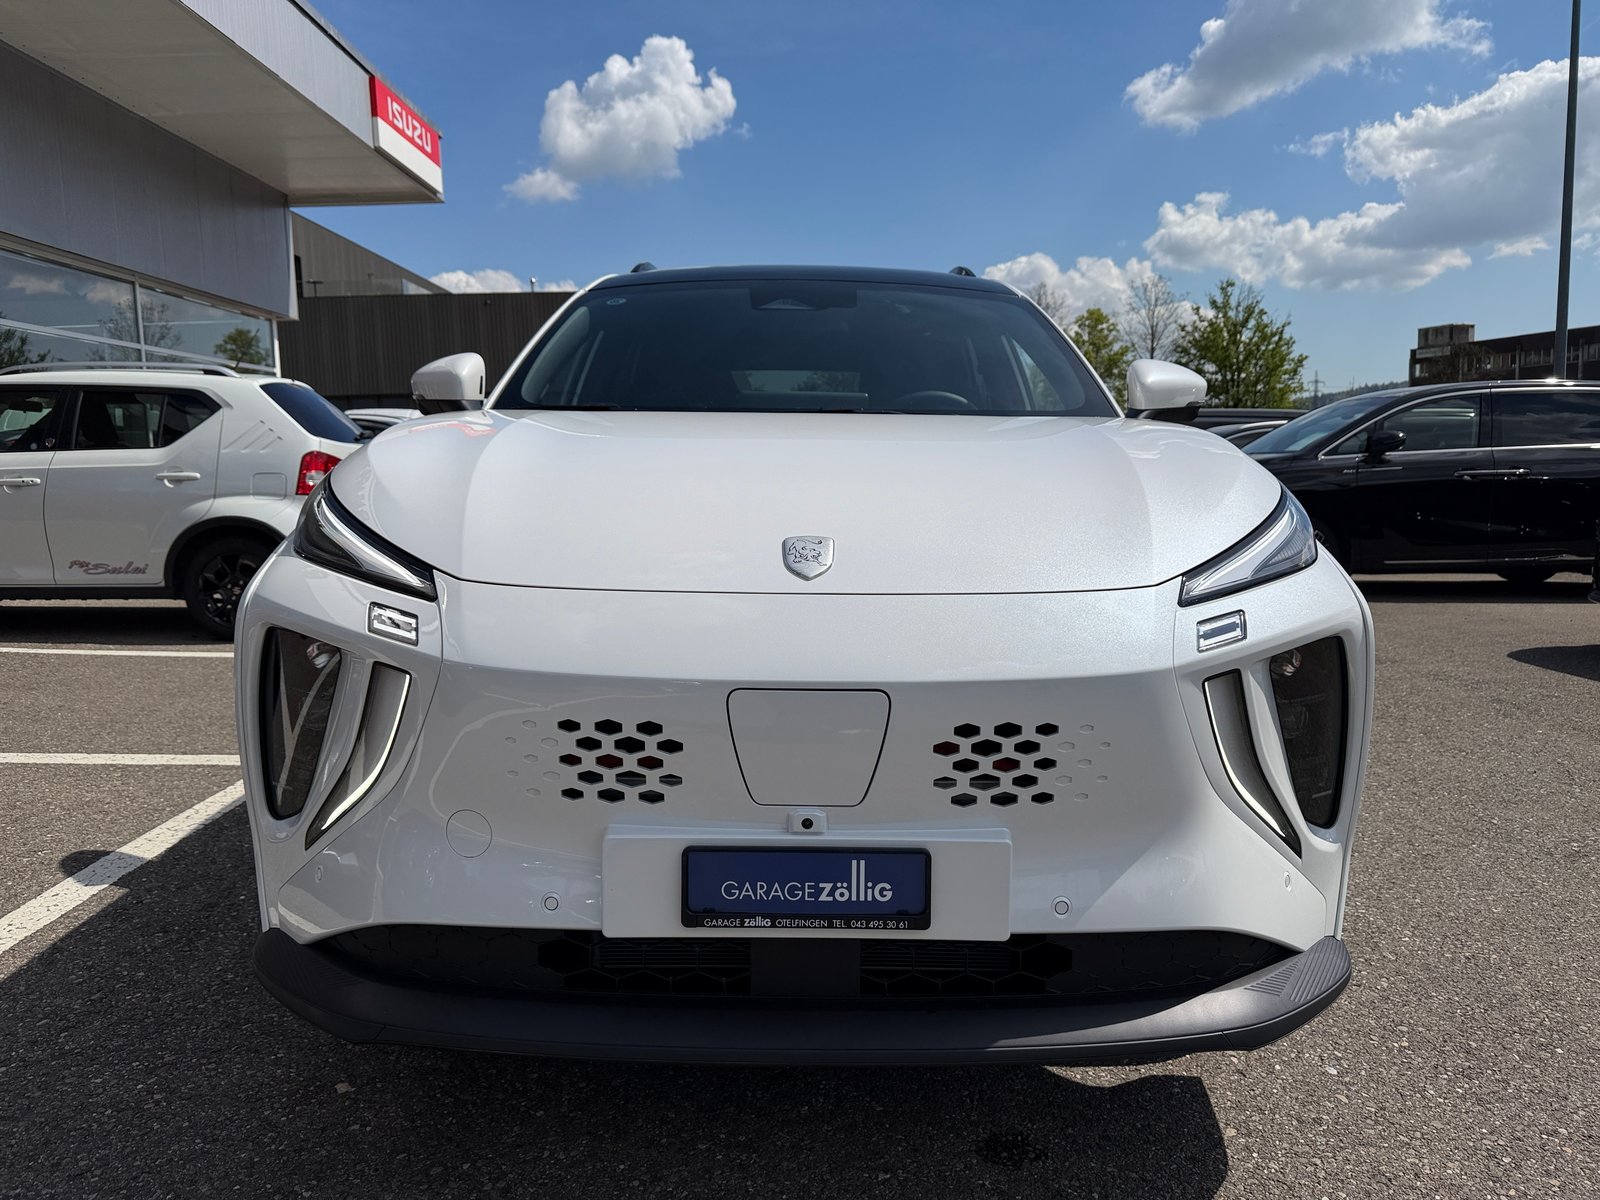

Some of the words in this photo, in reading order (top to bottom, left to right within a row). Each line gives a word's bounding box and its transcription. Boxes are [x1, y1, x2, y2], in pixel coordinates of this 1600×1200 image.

[387, 95, 433, 154] ISUZU
[721, 880, 815, 901] GARAGE
[703, 918, 741, 927] GARAGE
[775, 918, 828, 928] OTELFINGEN
[832, 919, 848, 928] TEL.
[850, 919, 866, 929] 043
[868, 920, 884, 929] 495
[886, 920, 897, 929] 30
[898, 920, 908, 929] 61
